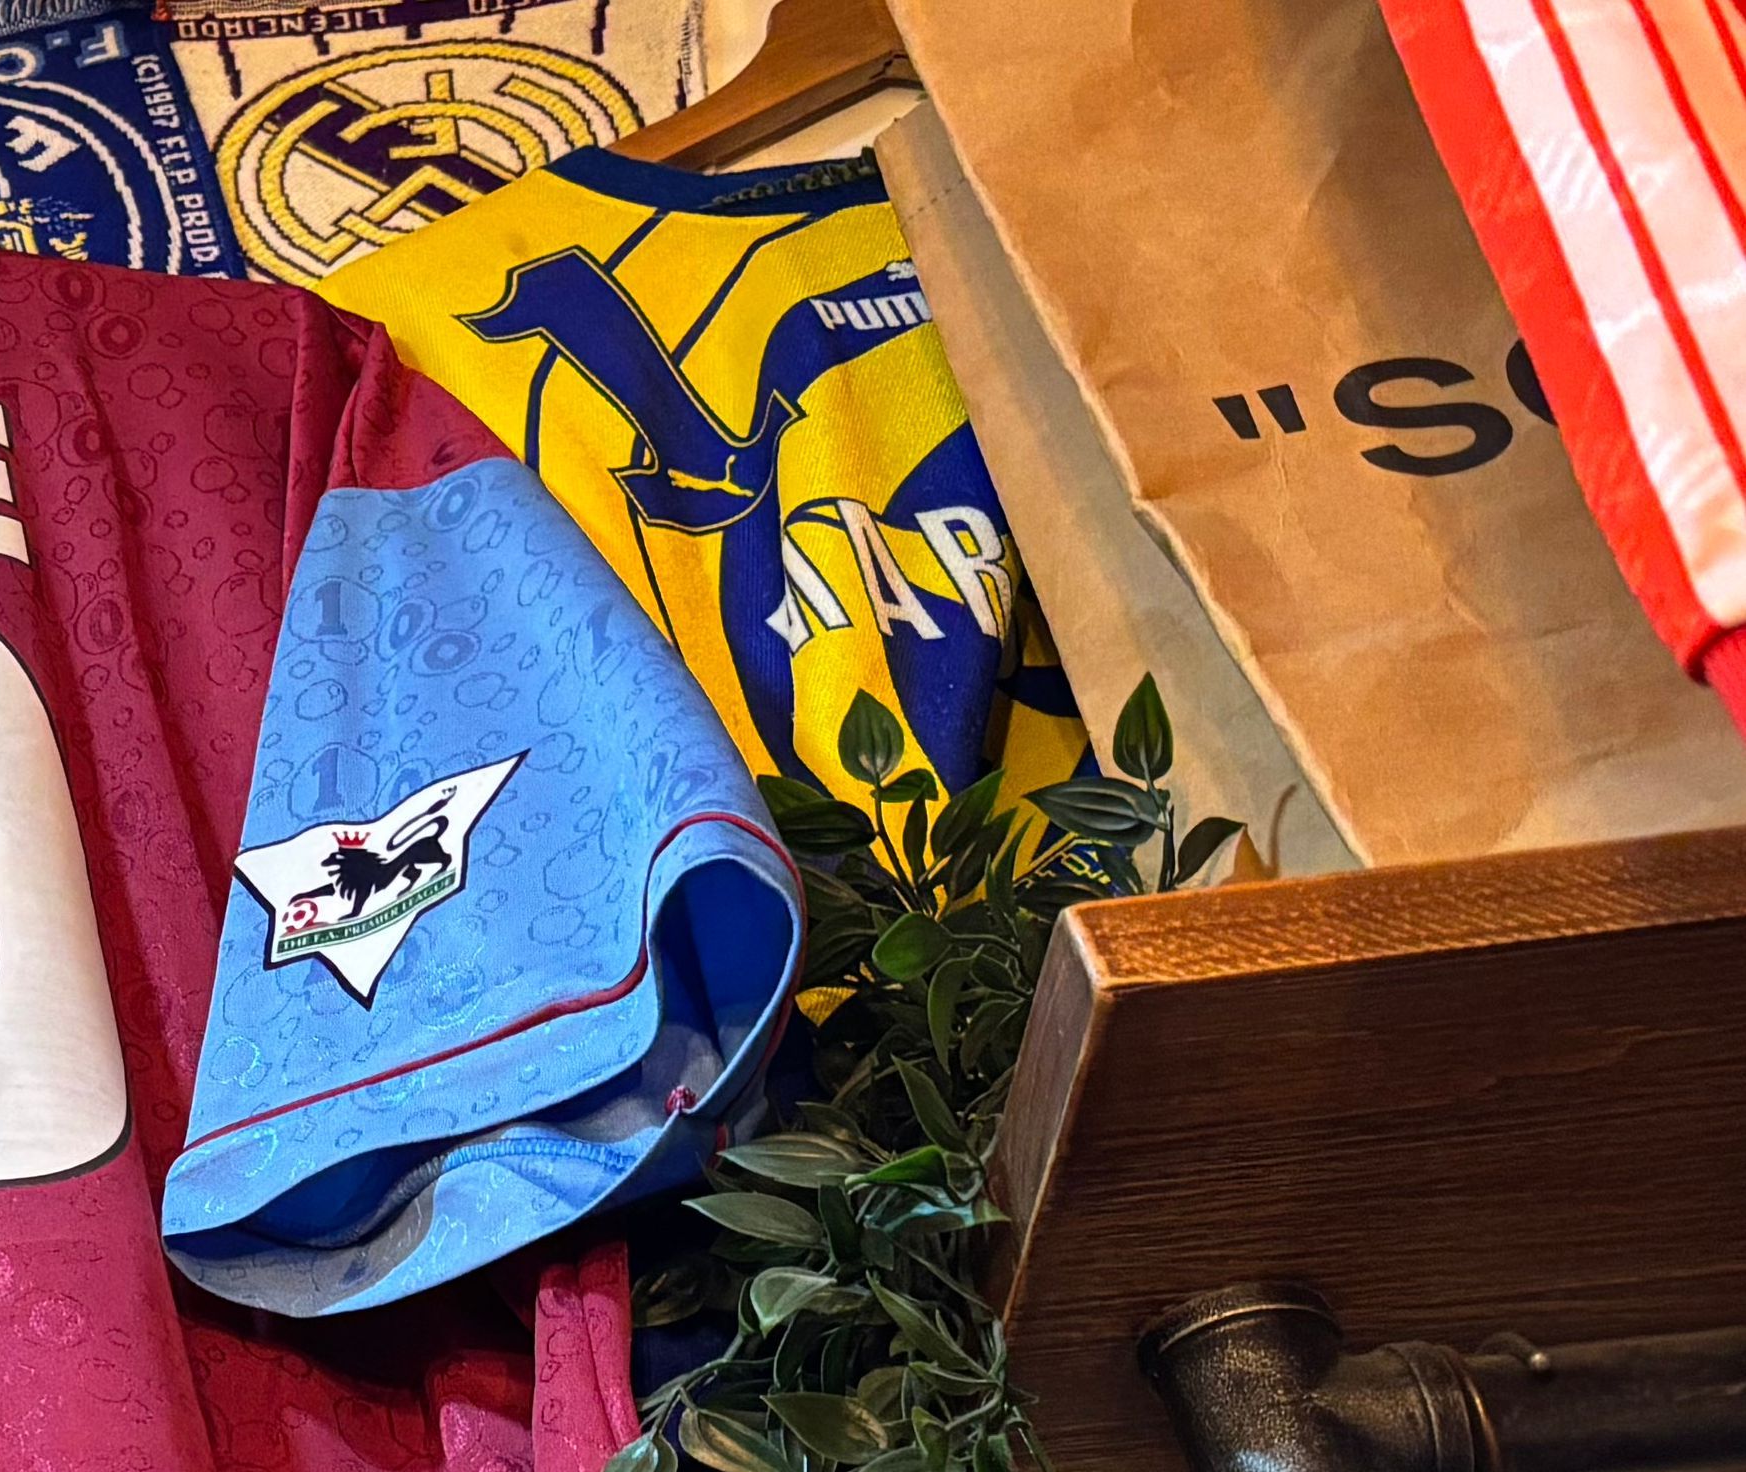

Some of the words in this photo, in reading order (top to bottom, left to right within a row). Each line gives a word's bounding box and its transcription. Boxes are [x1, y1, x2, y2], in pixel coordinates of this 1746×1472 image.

[809, 290, 935, 332] PUM
[344, 906, 400, 939] PREMIER
[402, 873, 455, 914] LEAGUE
